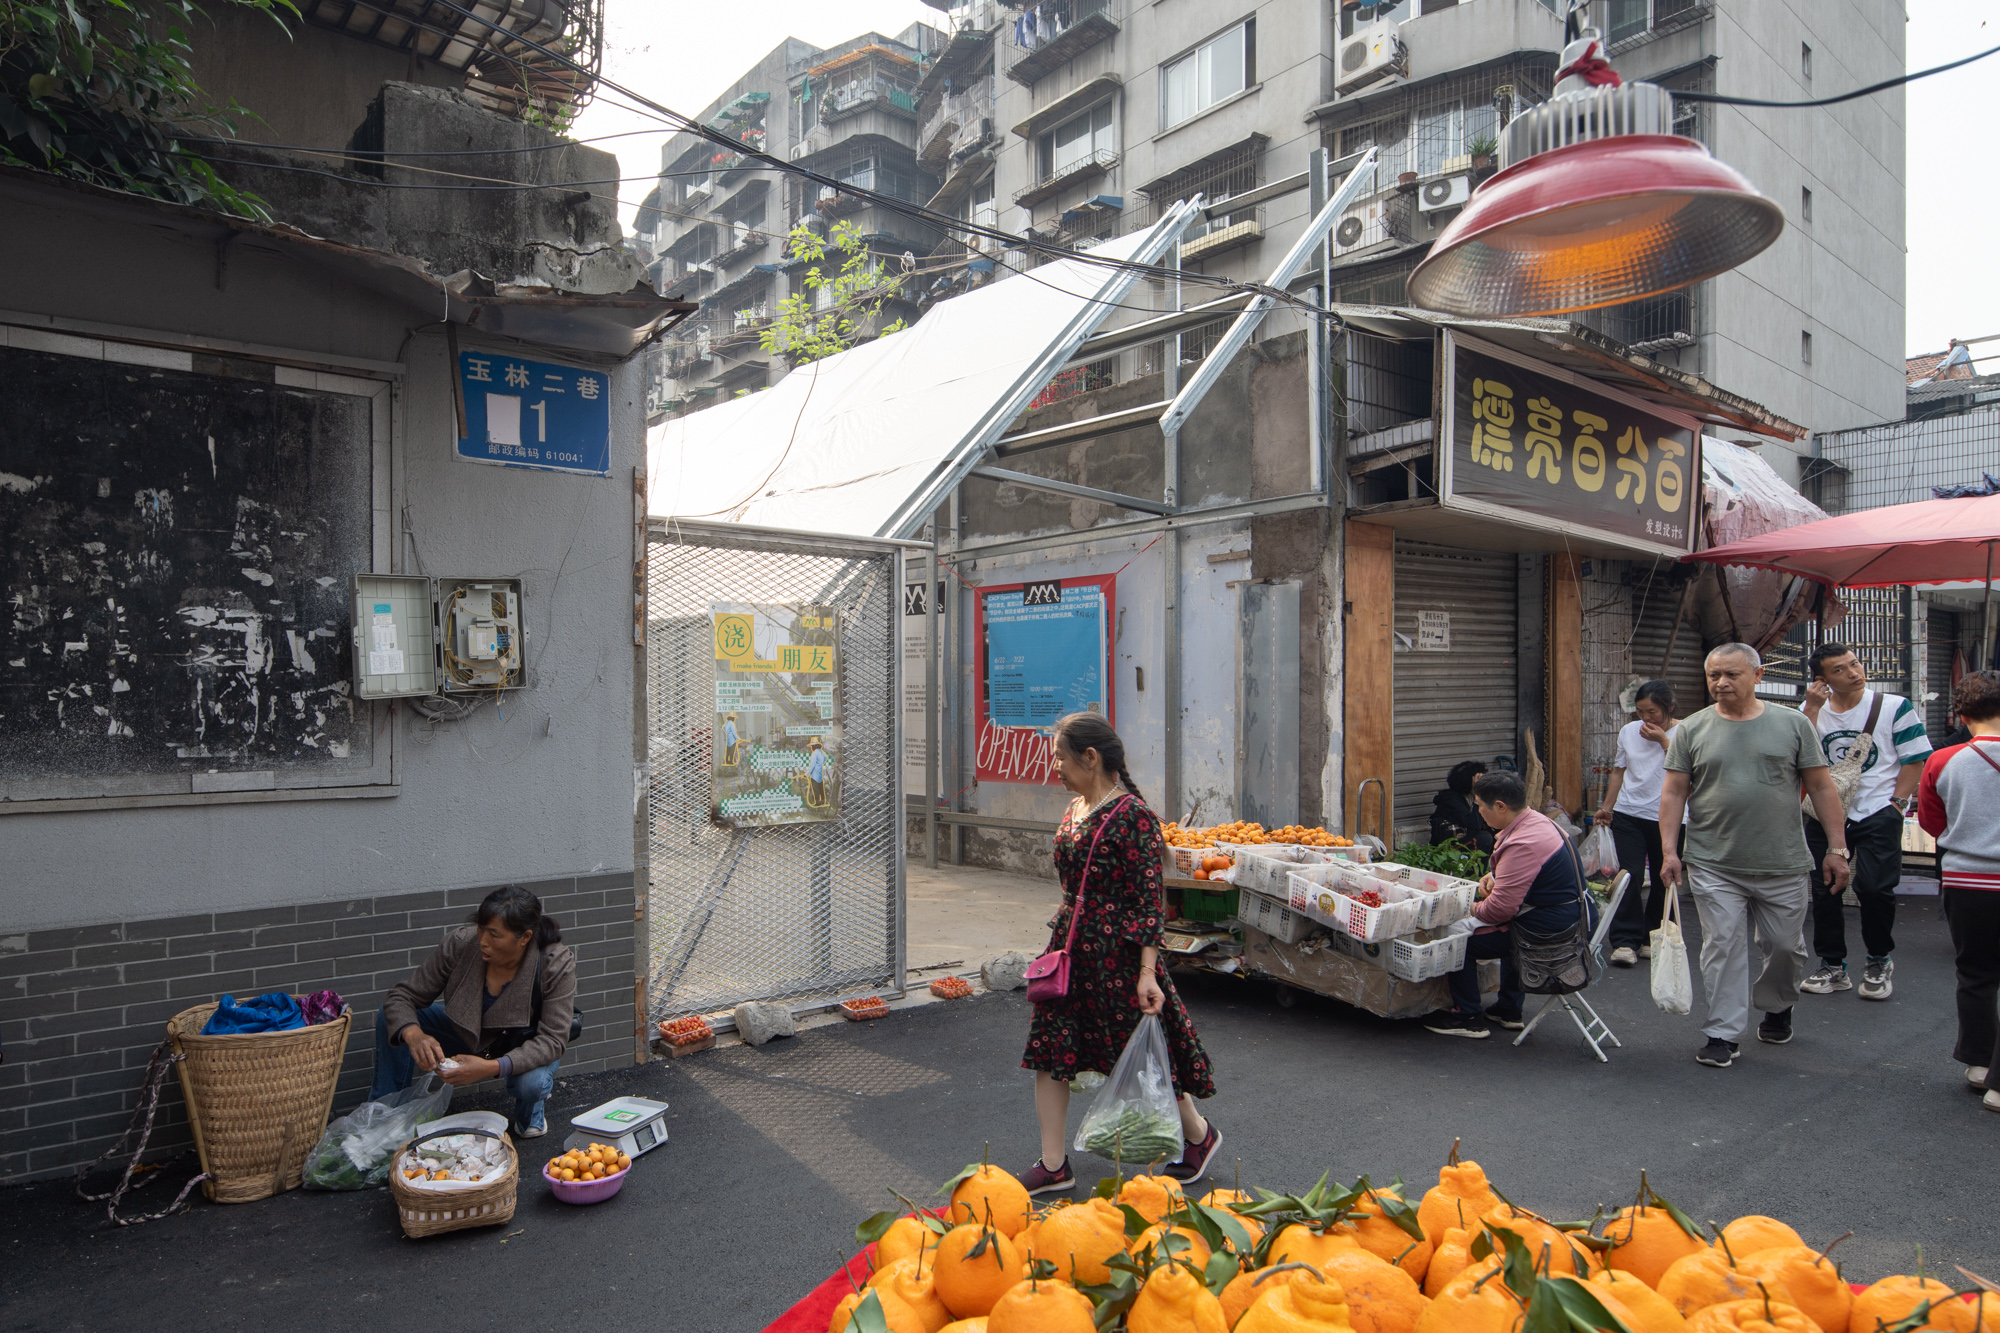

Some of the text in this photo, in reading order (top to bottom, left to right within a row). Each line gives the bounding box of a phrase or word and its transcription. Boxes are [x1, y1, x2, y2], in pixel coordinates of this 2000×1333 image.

[467, 358, 600, 400] 玉林二巷
[530, 400, 546, 442] 1
[488, 443, 539, 459] 邮政编码
[1471, 377, 1686, 512] 漂亮百分百
[724, 624, 745, 649] 浇
[782, 648, 828, 671] 朋友
[977, 717, 1026, 780] OPEN
